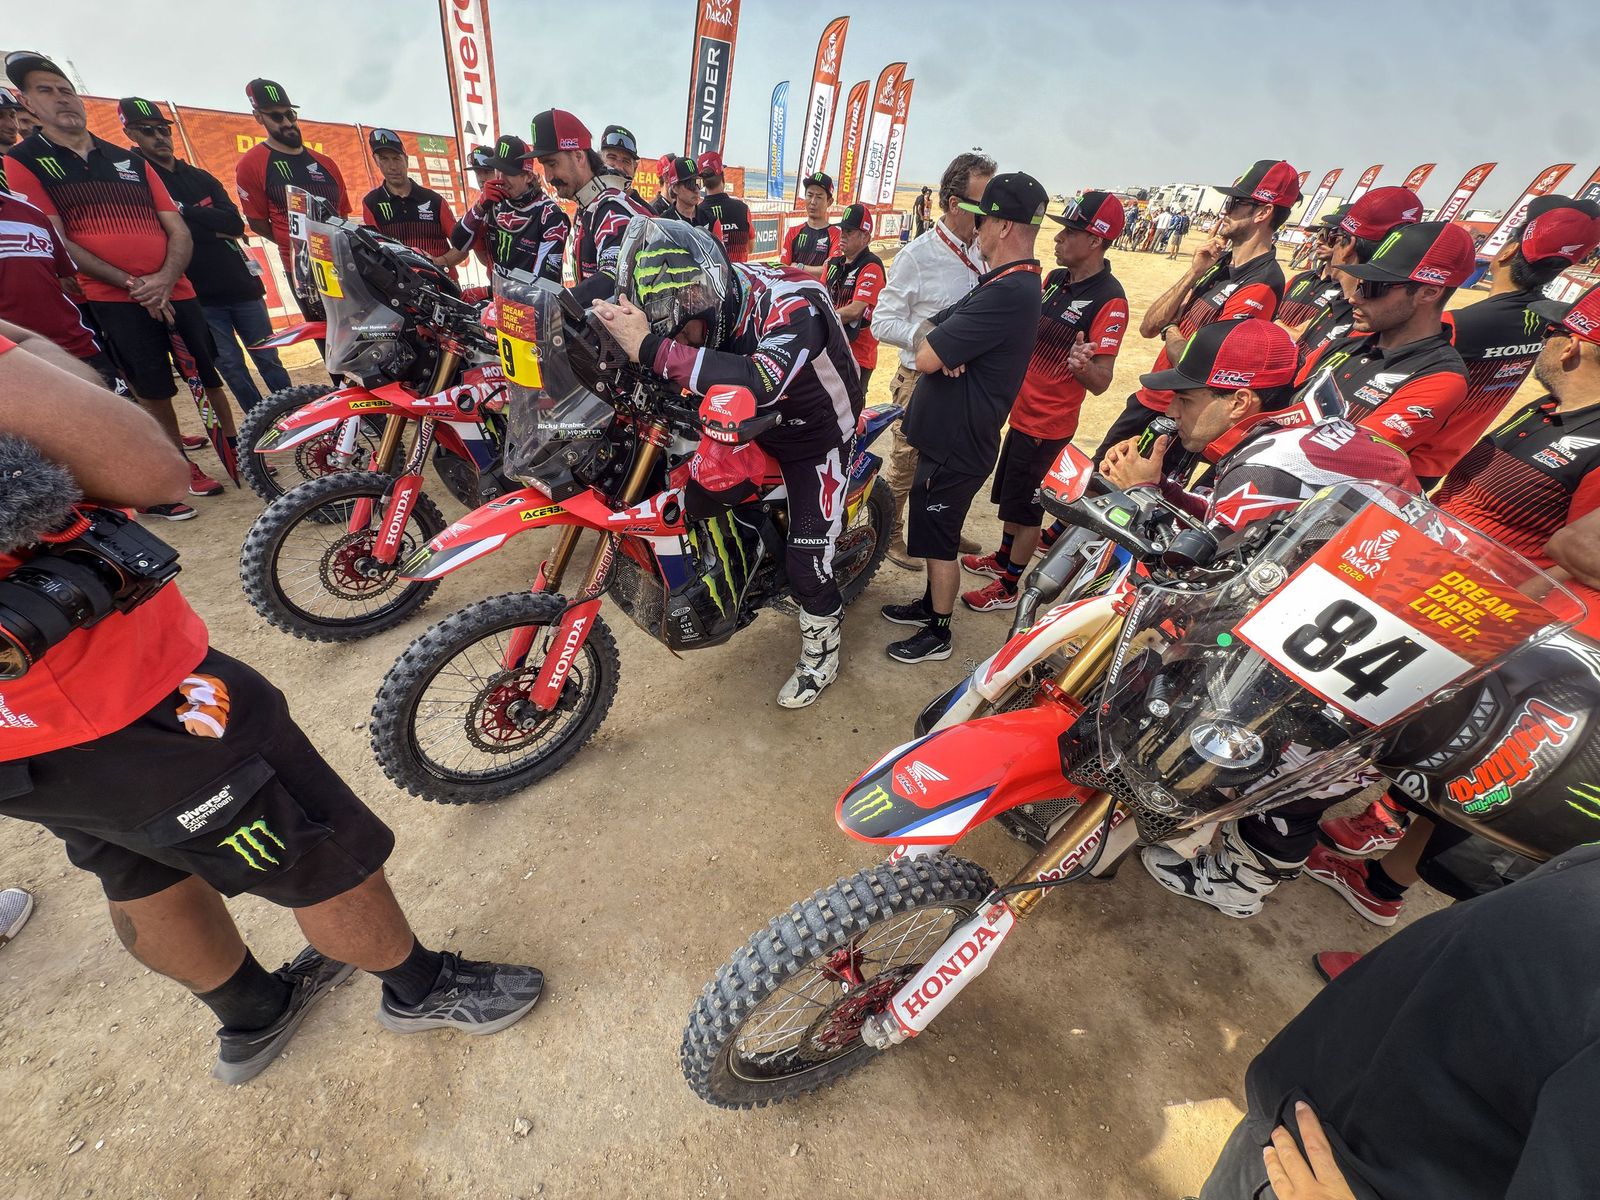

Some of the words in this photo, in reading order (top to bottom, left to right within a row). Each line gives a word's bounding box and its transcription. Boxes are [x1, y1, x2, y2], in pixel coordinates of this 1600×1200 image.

[705, 2, 733, 27] DAKAR
[698, 47, 721, 156] FENDER
[805, 94, 825, 178] FGoodrich
[883, 140, 898, 187] TUDOR
[1440, 196, 1467, 222] OTUL
[755, 230, 777, 242] NDER
[502, 304, 525, 319] DREAM.
[503, 312, 520, 325] DARE.
[503, 320, 515, 331] LIVE
[482, 366, 504, 379] MOT
[502, 337, 516, 378] 9
[1212, 370, 1255, 386] HRC
[708, 405, 732, 417] HONDA
[705, 428, 735, 442] MOTUL
[1548, 441, 1577, 461] HONDA
[386, 488, 412, 546] HONDA
[793, 537, 829, 546] HONDA
[1337, 563, 1365, 582] 2026
[1341, 546, 1382, 579] DAKAR
[1424, 583, 1487, 625] DARE.
[1439, 570, 1520, 623] DREAM.
[1126, 597, 1146, 639] Martim
[1408, 596, 1460, 629] LIVE
[1451, 622, 1481, 644] IT.
[547, 616, 587, 690] HONDA
[1110, 641, 1130, 685] Ventura
[1282, 598, 1428, 702] 84
[904, 765, 928, 796] HONDA
[902, 922, 1000, 1020] HONDA
